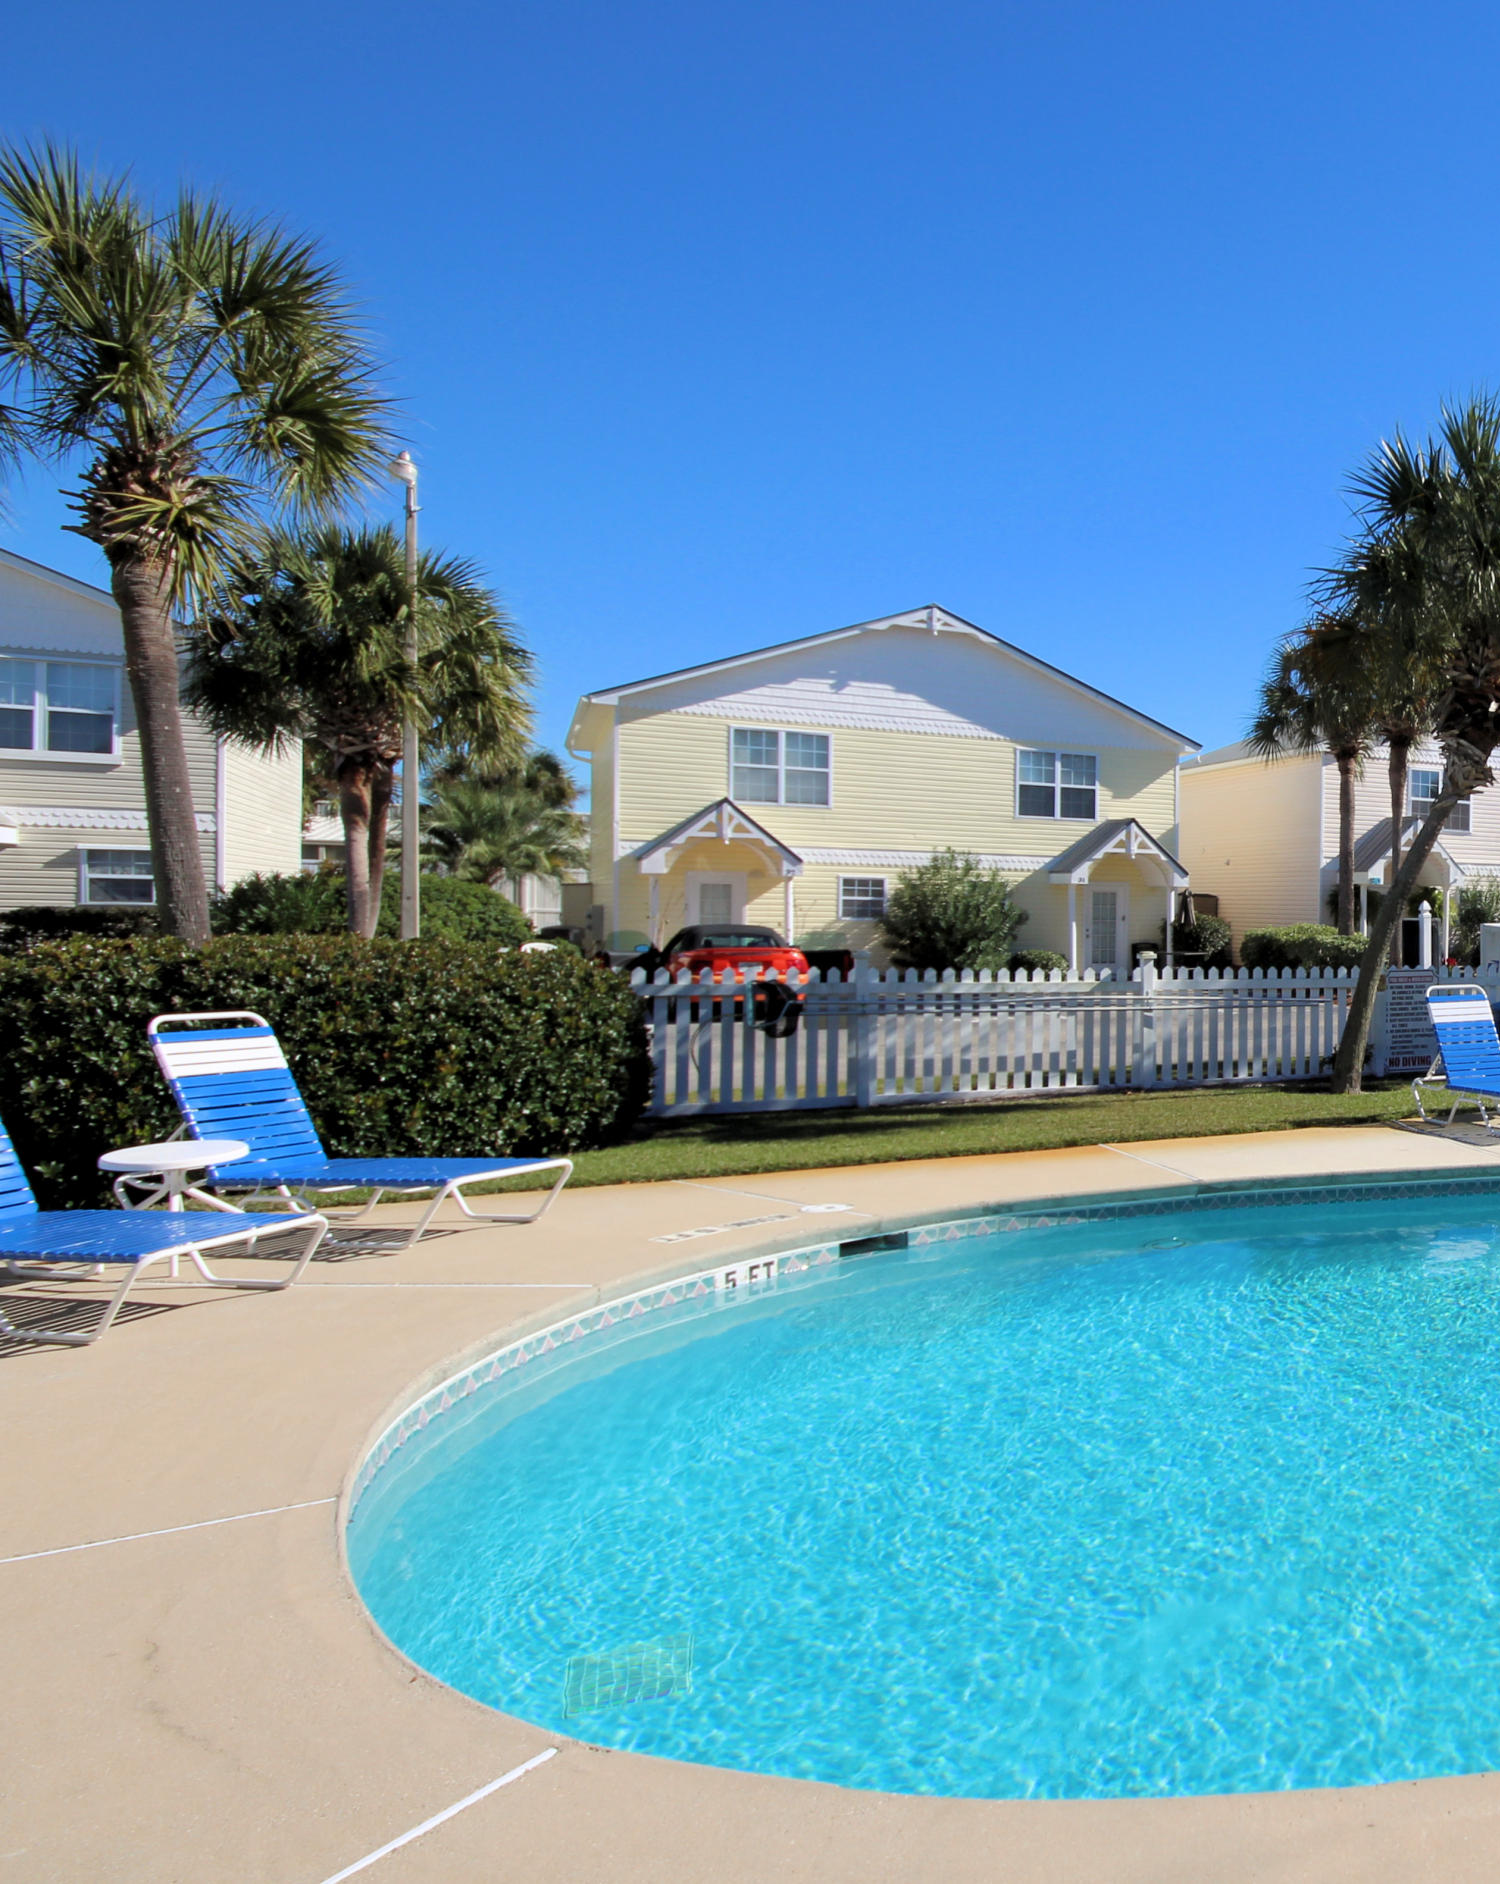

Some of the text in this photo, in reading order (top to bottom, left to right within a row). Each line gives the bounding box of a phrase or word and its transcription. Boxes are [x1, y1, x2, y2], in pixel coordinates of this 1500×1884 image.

[1389, 1055, 1432, 1067] NO DIVING
[724, 1260, 775, 1289] 5 FT
